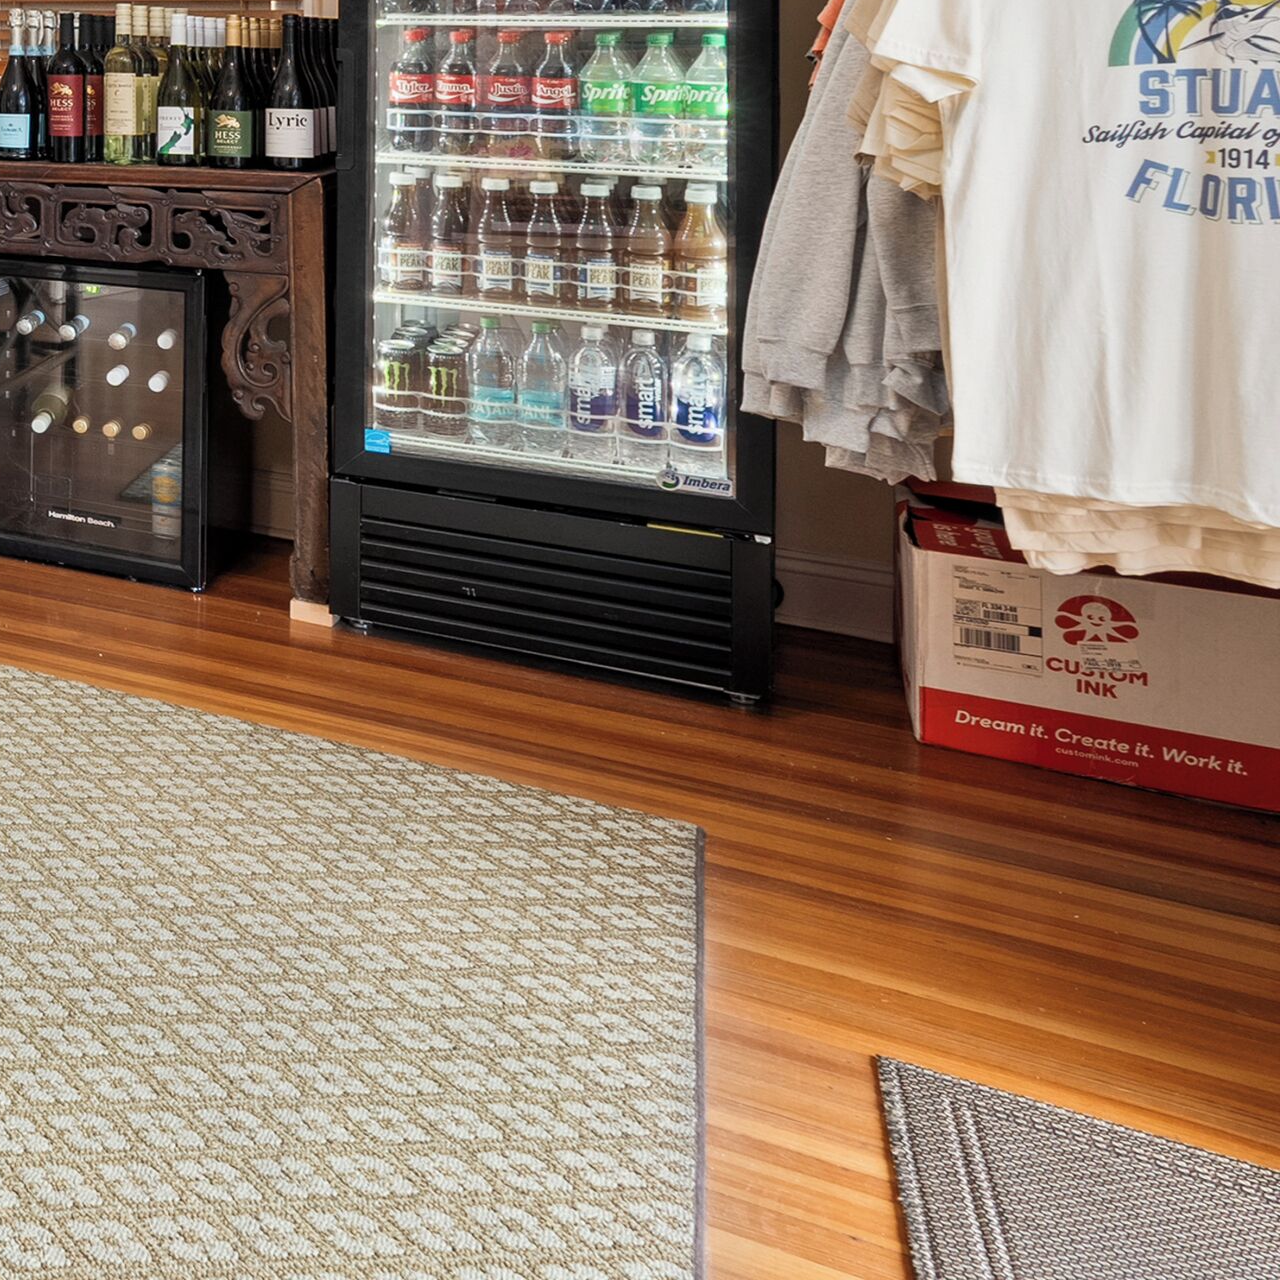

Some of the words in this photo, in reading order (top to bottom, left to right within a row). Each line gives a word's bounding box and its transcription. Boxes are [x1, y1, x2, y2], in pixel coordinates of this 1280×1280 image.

[397, 80, 428, 93] Tyler
[493, 83, 527, 97] Justin
[537, 84, 572, 98] Angel
[582, 83, 630, 102] Sprite
[49, 98, 74, 107] HESS
[268, 112, 308, 130] Lyric
[214, 130, 241, 140] HESS
[1082, 120, 1174, 149] Sailfish
[1176, 120, 1262, 144] Capital
[1217, 148, 1271, 170] 1914
[631, 276, 659, 287] PEAK
[635, 378, 655, 430] smart
[682, 476, 731, 492] Imbera
[48, 510, 86, 523] Hamilton
[1076, 678, 1119, 699] INK
[955, 709, 1026, 736] Dream
[1030, 723, 1049, 740] it.
[1054, 727, 1131, 754] Create
[1134, 741, 1155, 759] it.
[1162, 746, 1223, 771] Work
[1226, 758, 1248, 776] it.
[1055, 746, 1140, 768] customink.com
